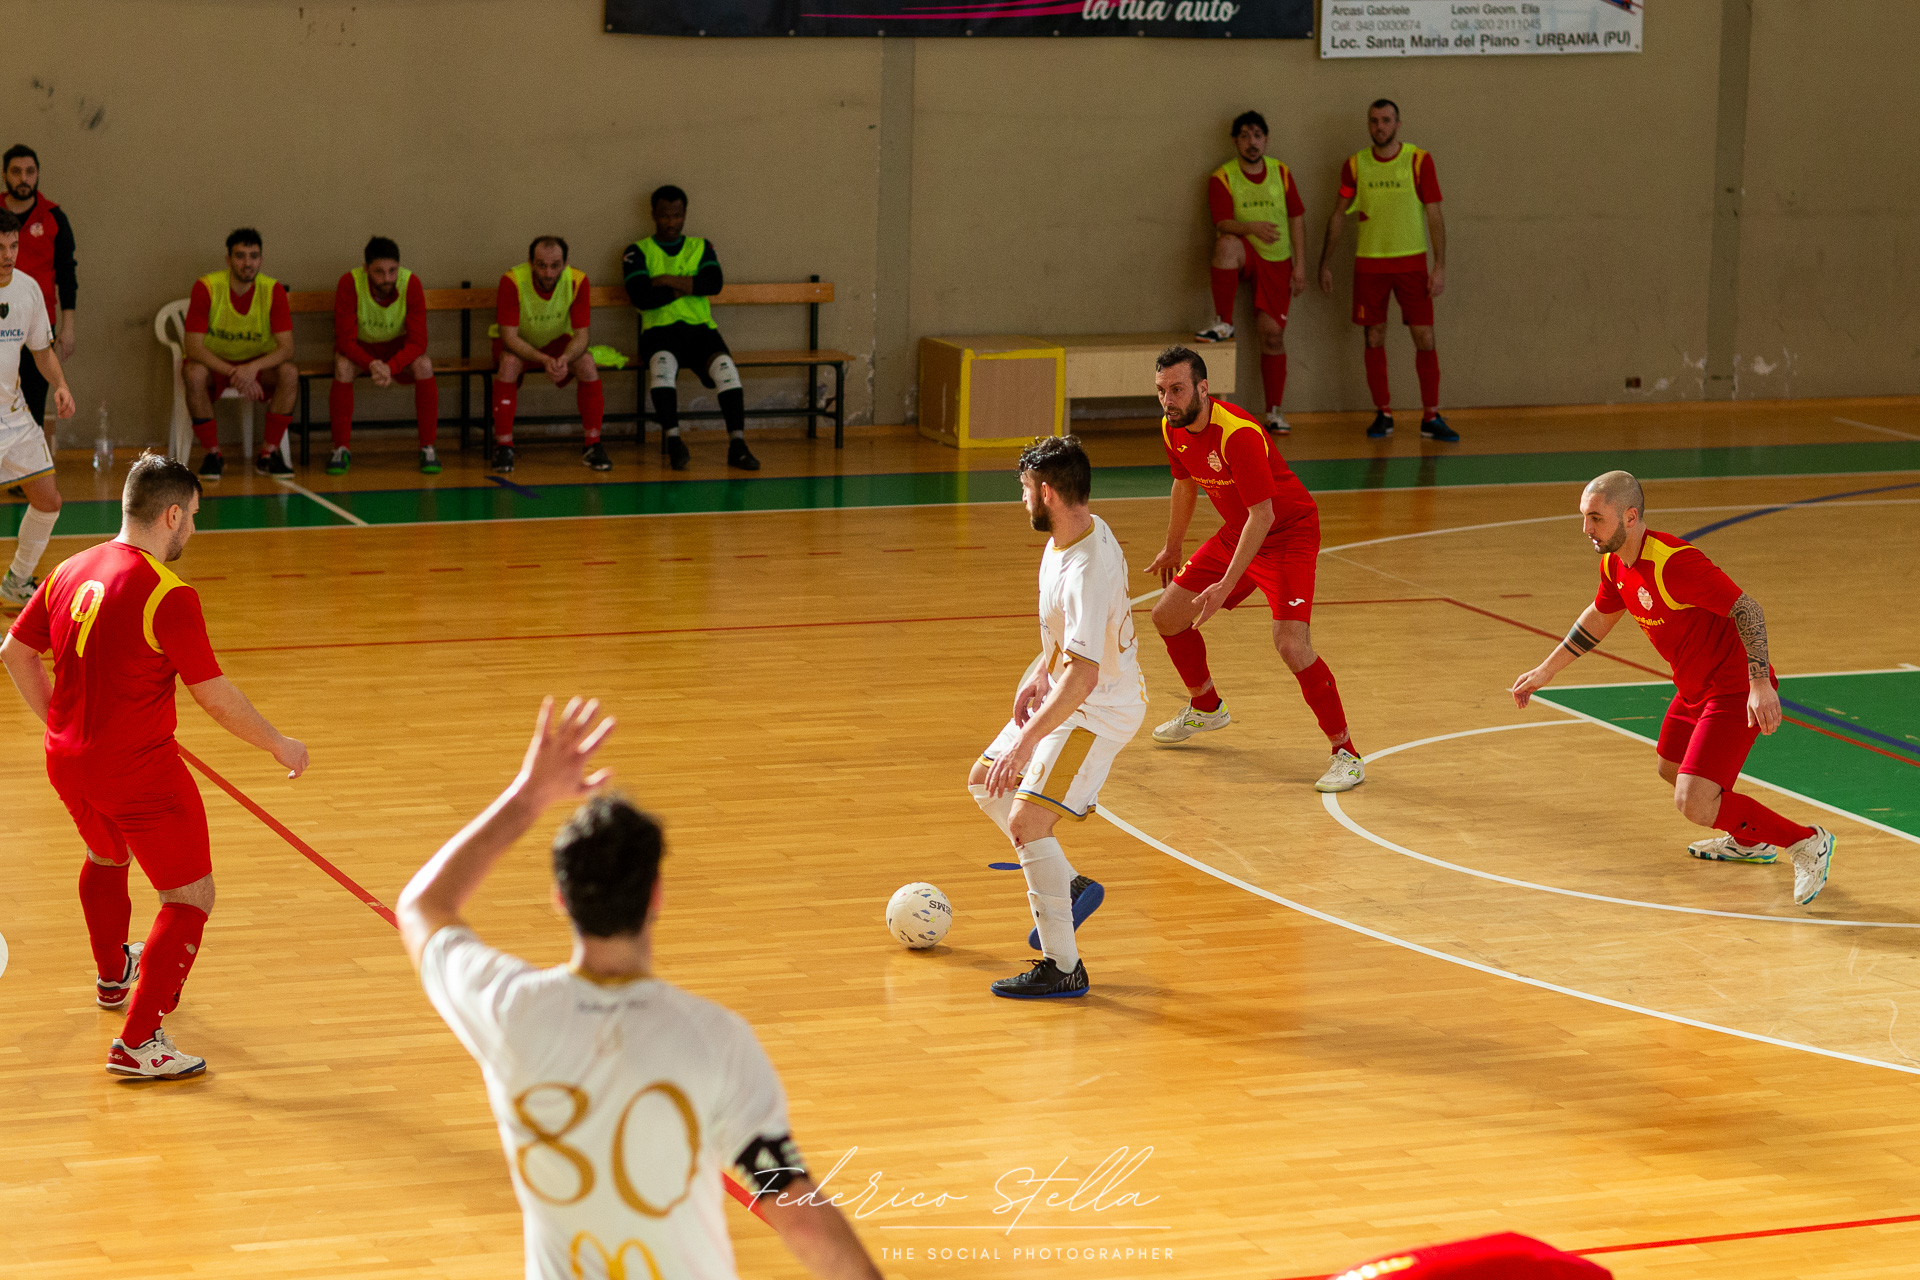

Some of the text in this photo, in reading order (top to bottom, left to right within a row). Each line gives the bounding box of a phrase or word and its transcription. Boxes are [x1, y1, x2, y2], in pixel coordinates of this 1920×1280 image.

[1082, 0, 1240, 22] la tua auto
[1331, 5, 1411, 15] Arcasi Gabriele
[1451, 4, 1480, 15] Leoni
[1521, 3, 1541, 14] Elia
[1331, 36, 1361, 49] Loc.
[1366, 35, 1406, 49] Santa
[1410, 35, 1449, 48] Maria
[1454, 34, 1475, 47] del
[1480, 34, 1520, 47] Piano
[1536, 32, 1600, 46] URBANIA
[1603, 31, 1631, 46] (PU)
[70, 579, 106, 658] 9
[1026, 761, 1046, 787] 9
[512, 1080, 701, 1220] 80
